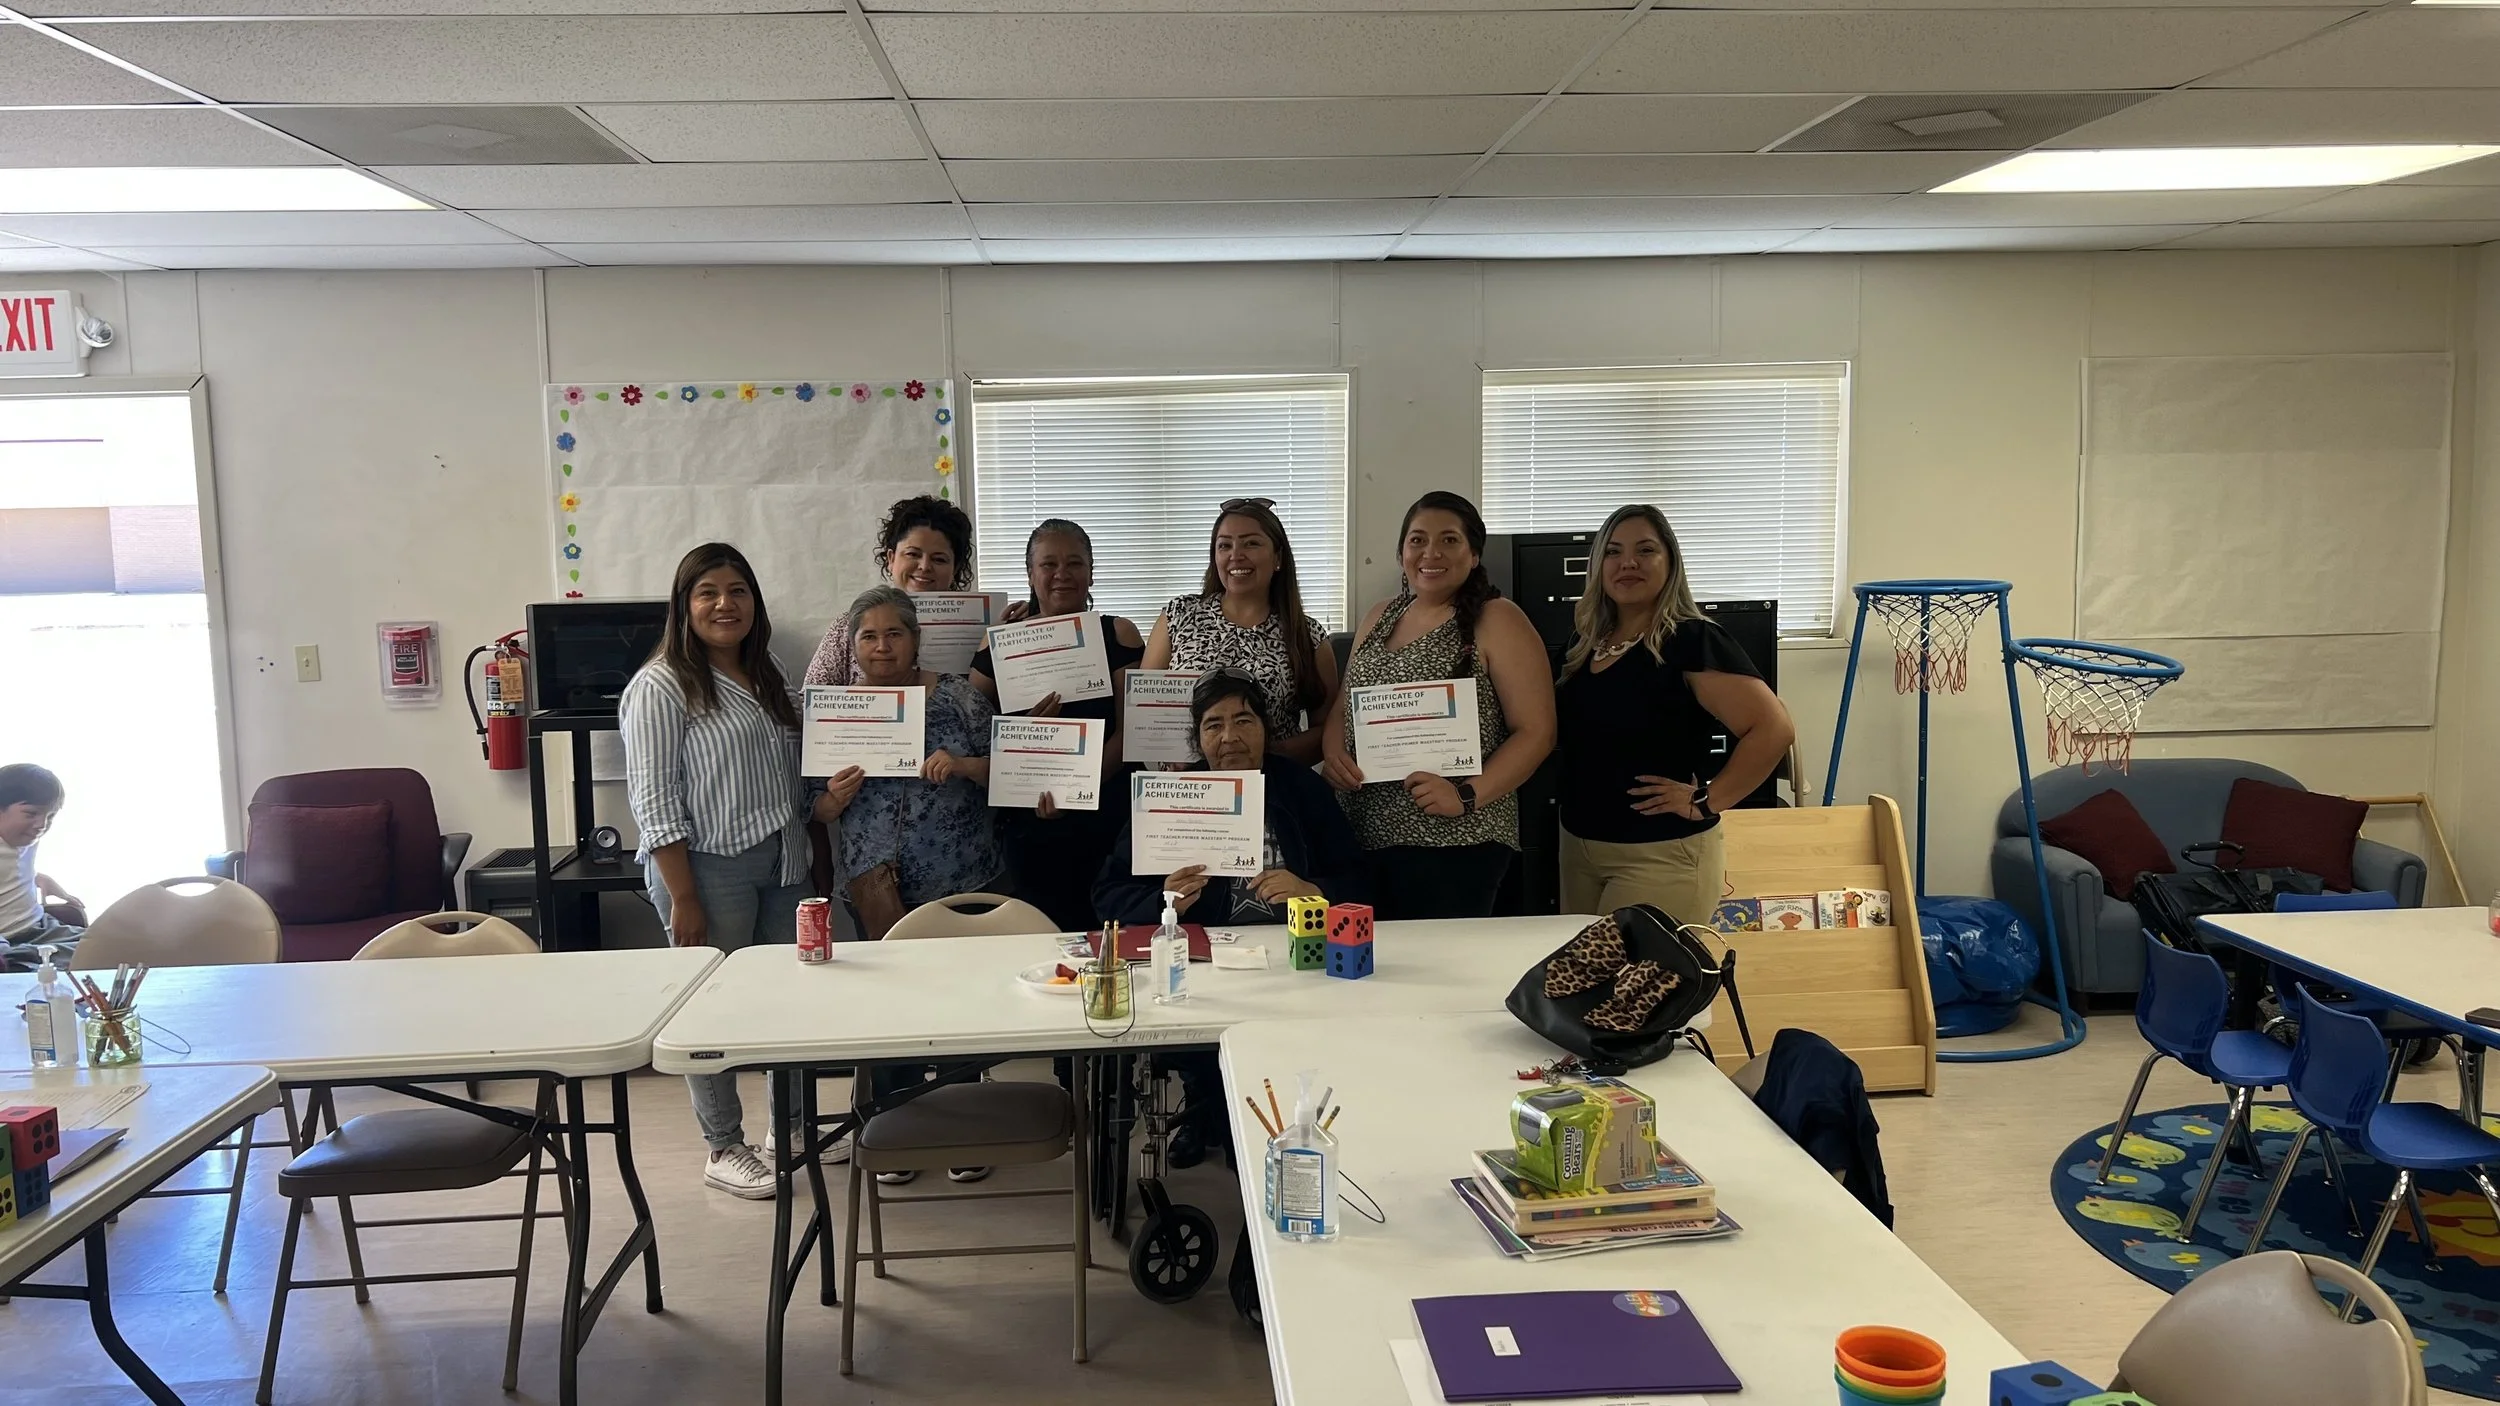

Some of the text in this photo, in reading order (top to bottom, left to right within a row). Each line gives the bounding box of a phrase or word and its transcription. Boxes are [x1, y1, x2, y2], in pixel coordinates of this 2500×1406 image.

[0, 298, 54, 351] XIT
[997, 628, 1044, 640] CERTIFICATE
[998, 634, 1053, 648] PARTICIPATION
[392, 643, 418, 653] FIRE
[1361, 692, 1412, 703] CERTIFICATE
[1362, 700, 1419, 711] ACHIEVEMENT
[1000, 725, 1048, 733] CERTIFICATE
[1145, 782, 1199, 790] CERTIFICATE
[1145, 791, 1205, 799] ACHIEVEMENT
[1572, 1142, 1581, 1175] Bears
